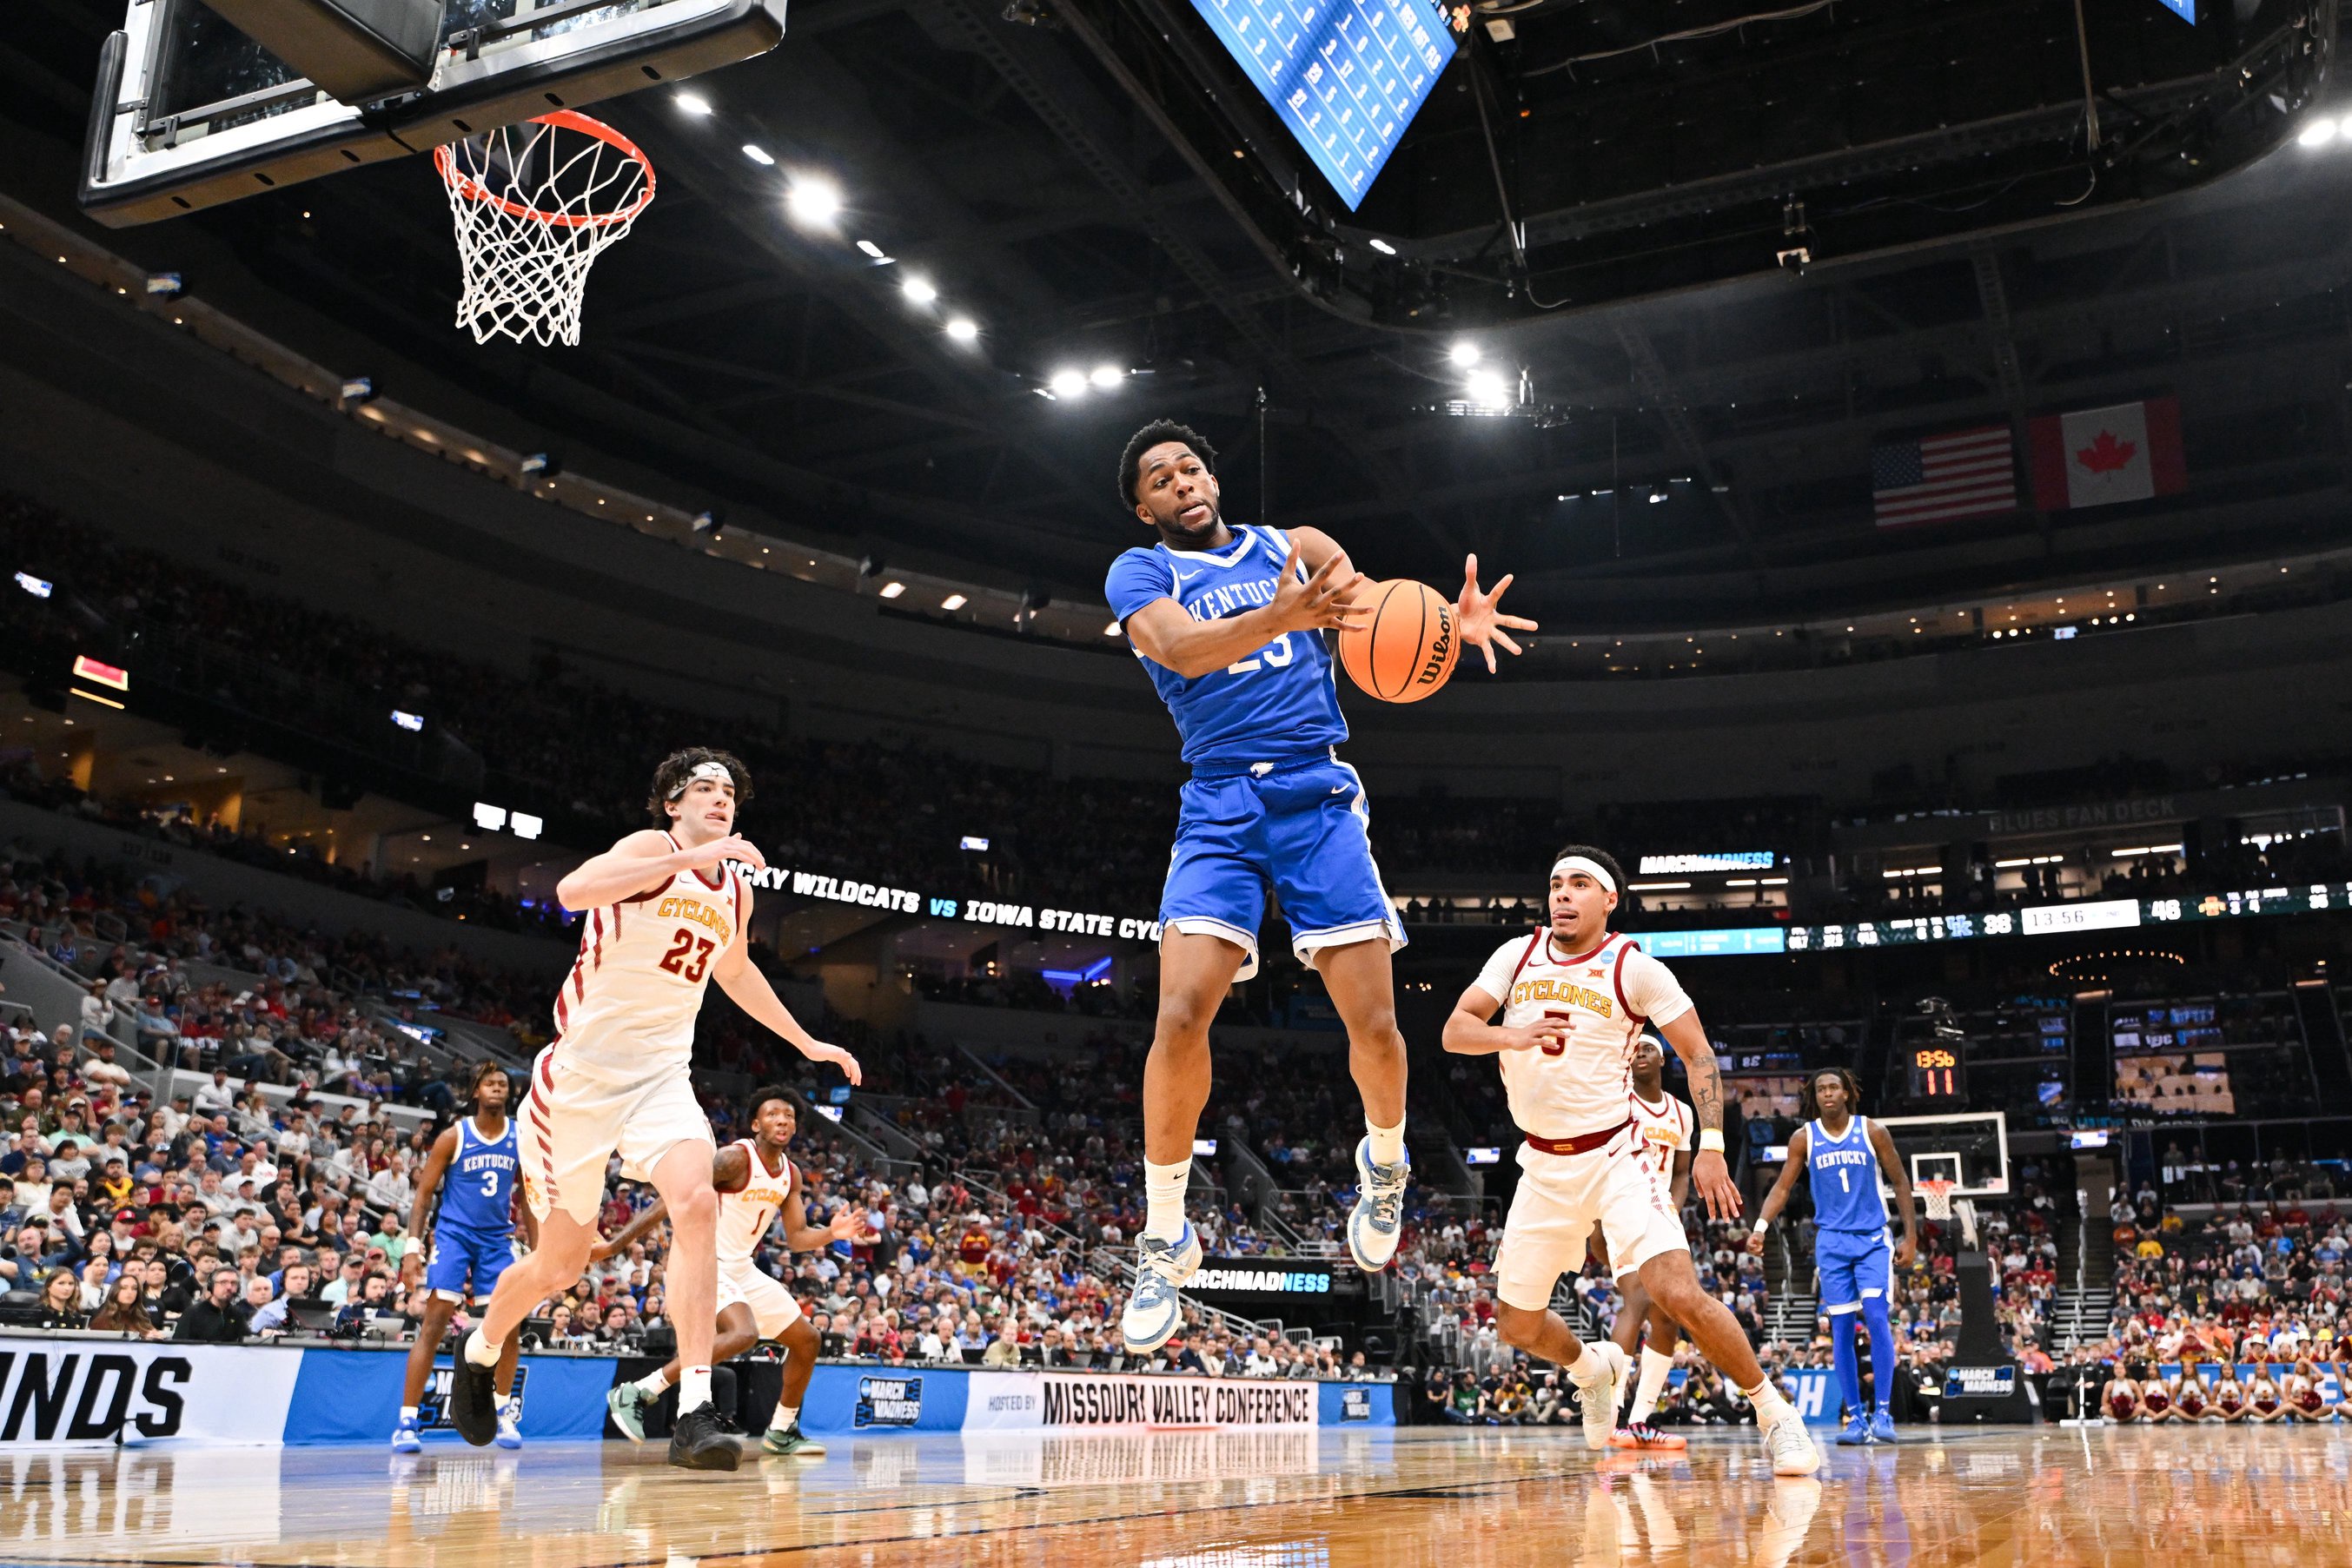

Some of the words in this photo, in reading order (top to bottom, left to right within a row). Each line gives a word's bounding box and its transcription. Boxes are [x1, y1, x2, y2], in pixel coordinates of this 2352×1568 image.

[1189, 577, 1281, 623] KENTUC
[1417, 606, 1450, 685] Wilson
[1989, 807, 2059, 832] BLUES
[2065, 804, 2108, 826] FAN
[2115, 798, 2176, 822] DECK
[793, 871, 920, 913] WILDCATS
[930, 898, 957, 917] VS
[964, 900, 1033, 928] IOWA
[1039, 909, 1115, 936] STATE
[658, 897, 731, 947] CYCLONES
[1984, 913, 2011, 934] 38
[2033, 910, 2084, 927] 13:56
[659, 928, 716, 983] 23
[1514, 980, 1613, 1018] CYCLONES
[1917, 1049, 1955, 1068] 13:56
[1927, 1069, 1953, 1095] 11
[462, 1153, 515, 1173] KENTUCKY
[1815, 1149, 1867, 1170] KENTUCKY
[480, 1170, 499, 1197] 3
[1838, 1168, 1850, 1193] 1
[751, 1208, 765, 1235] 1
[1958, 1368, 1996, 1380] MARCH
[1964, 1379, 2013, 1393] MADNESS
[870, 1379, 905, 1399] MARCH
[874, 1399, 921, 1419] MADNESS
[989, 1395, 1023, 1411] HOSTED
[1025, 1395, 1037, 1410] BY
[1043, 1381, 1146, 1425] MISSOURI
[1152, 1384, 1210, 1424] VALLEY
[1216, 1386, 1309, 1424] CONFERENCE
